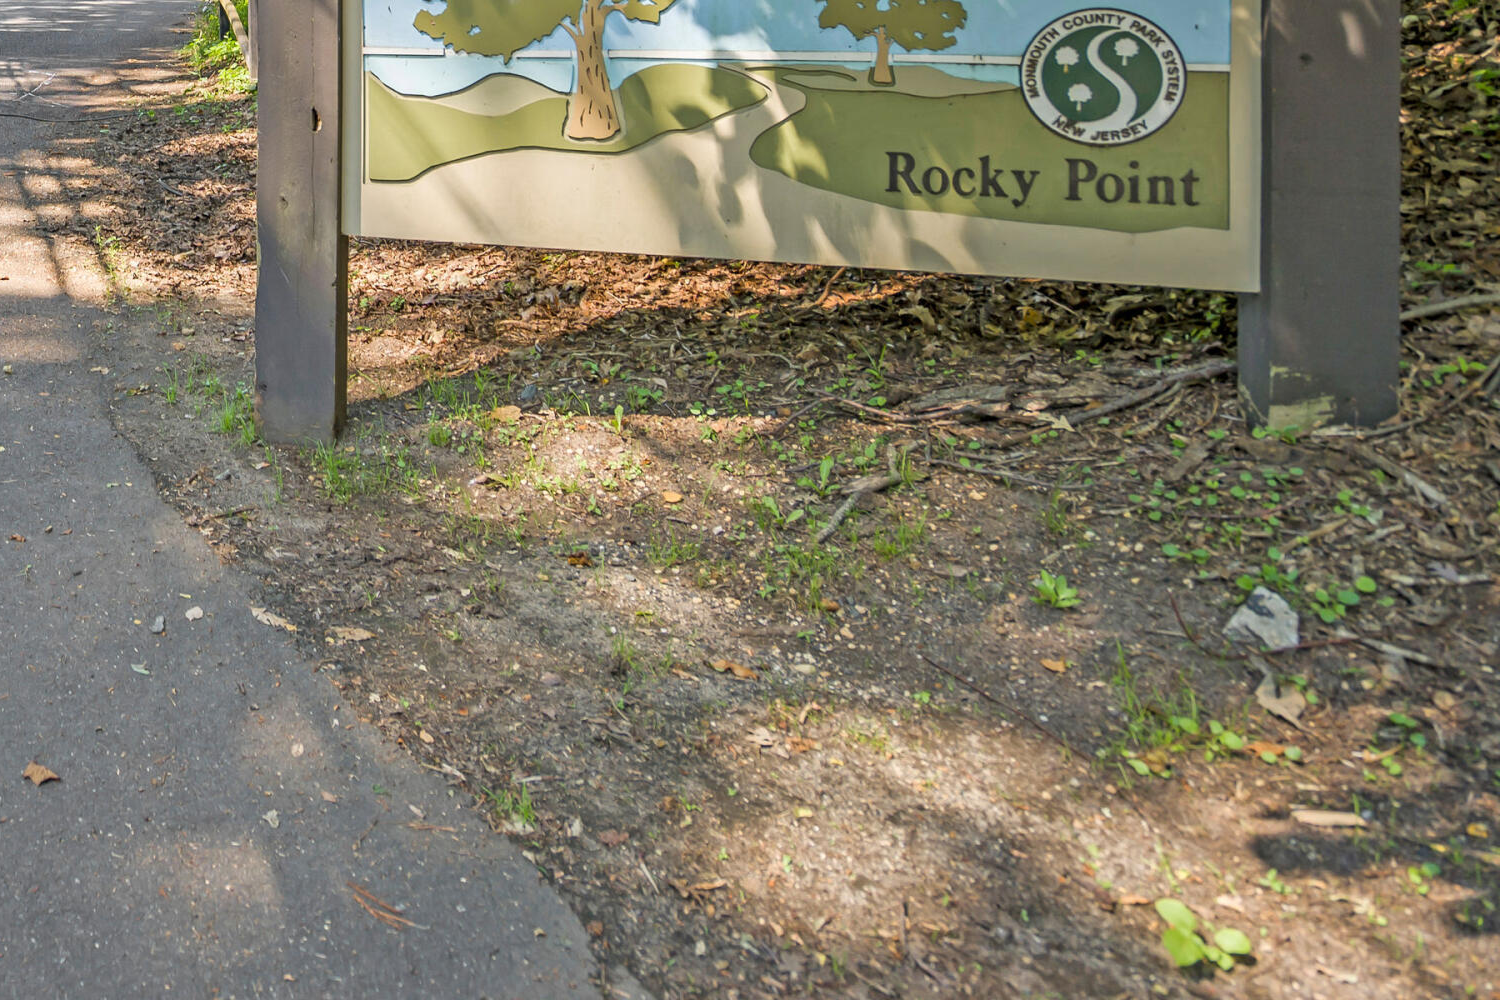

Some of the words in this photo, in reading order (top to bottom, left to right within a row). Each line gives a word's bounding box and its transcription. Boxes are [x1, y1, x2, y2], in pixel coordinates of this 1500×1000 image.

[1025, 28, 1060, 98] MONMOUTH
[1062, 13, 1126, 30] COUNTY
[1129, 20, 1165, 47] PARK
[1162, 50, 1180, 102] SYSTEM
[1052, 115, 1086, 137] NEW
[1090, 119, 1149, 140] JERSEY
[884, 151, 1041, 209] Rocky
[1063, 158, 1201, 207] Point
